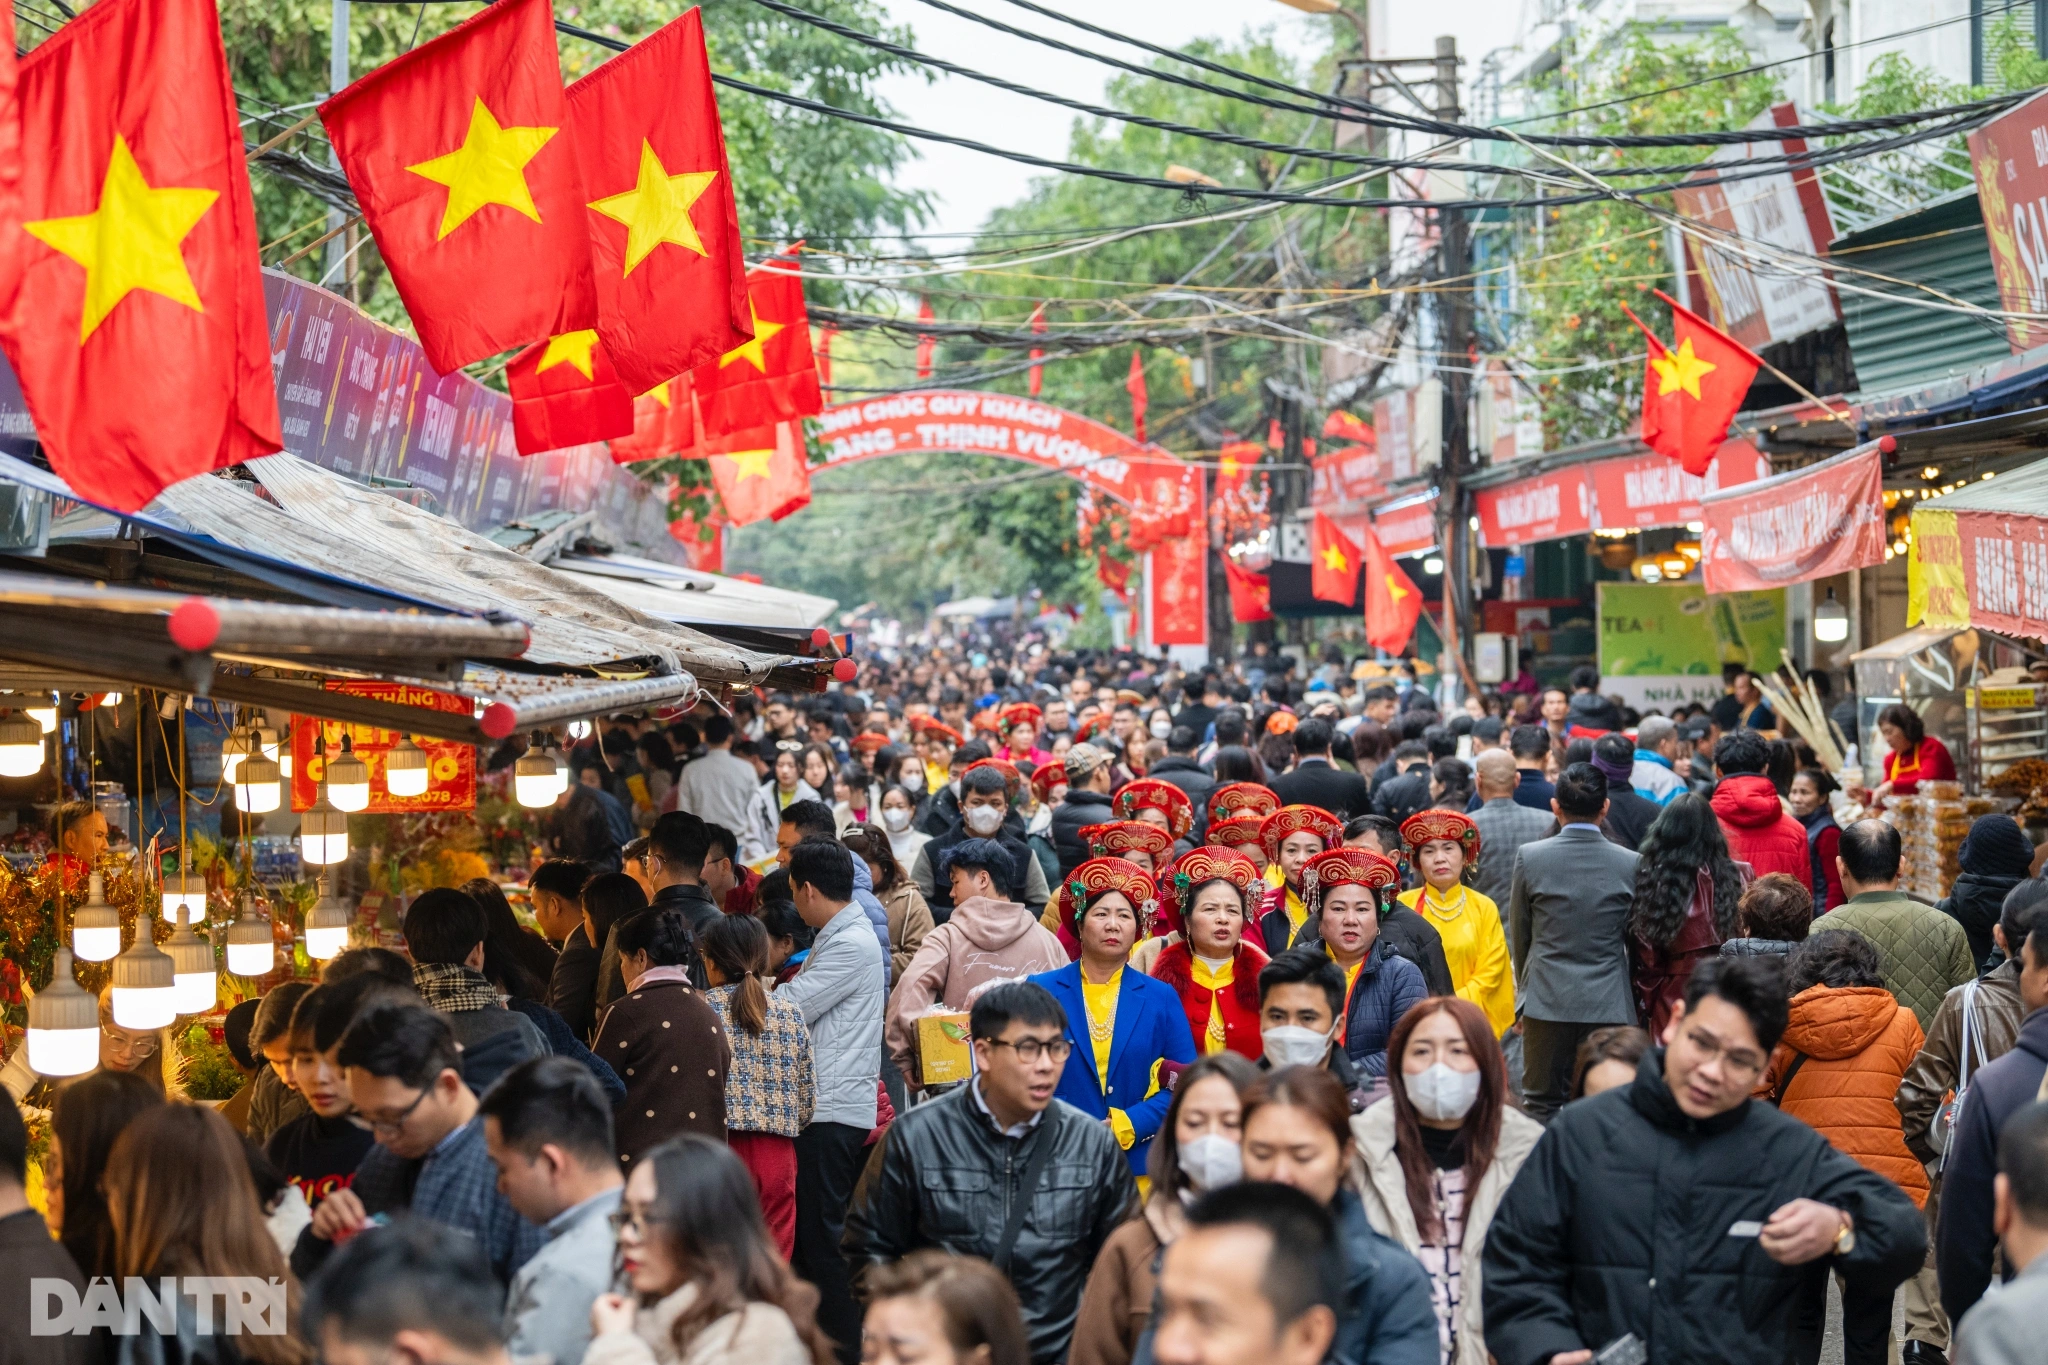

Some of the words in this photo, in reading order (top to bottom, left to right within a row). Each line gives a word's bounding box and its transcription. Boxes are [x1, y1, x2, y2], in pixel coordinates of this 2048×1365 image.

[862, 396, 928, 422] CHÚC
[928, 393, 978, 417] QUÝ
[981, 397, 1062, 430] KHÁCH
[916, 422, 1010, 453] THỊNH
[1975, 522, 2021, 617] NHÀ
[1645, 684, 1686, 701] NHÀ
